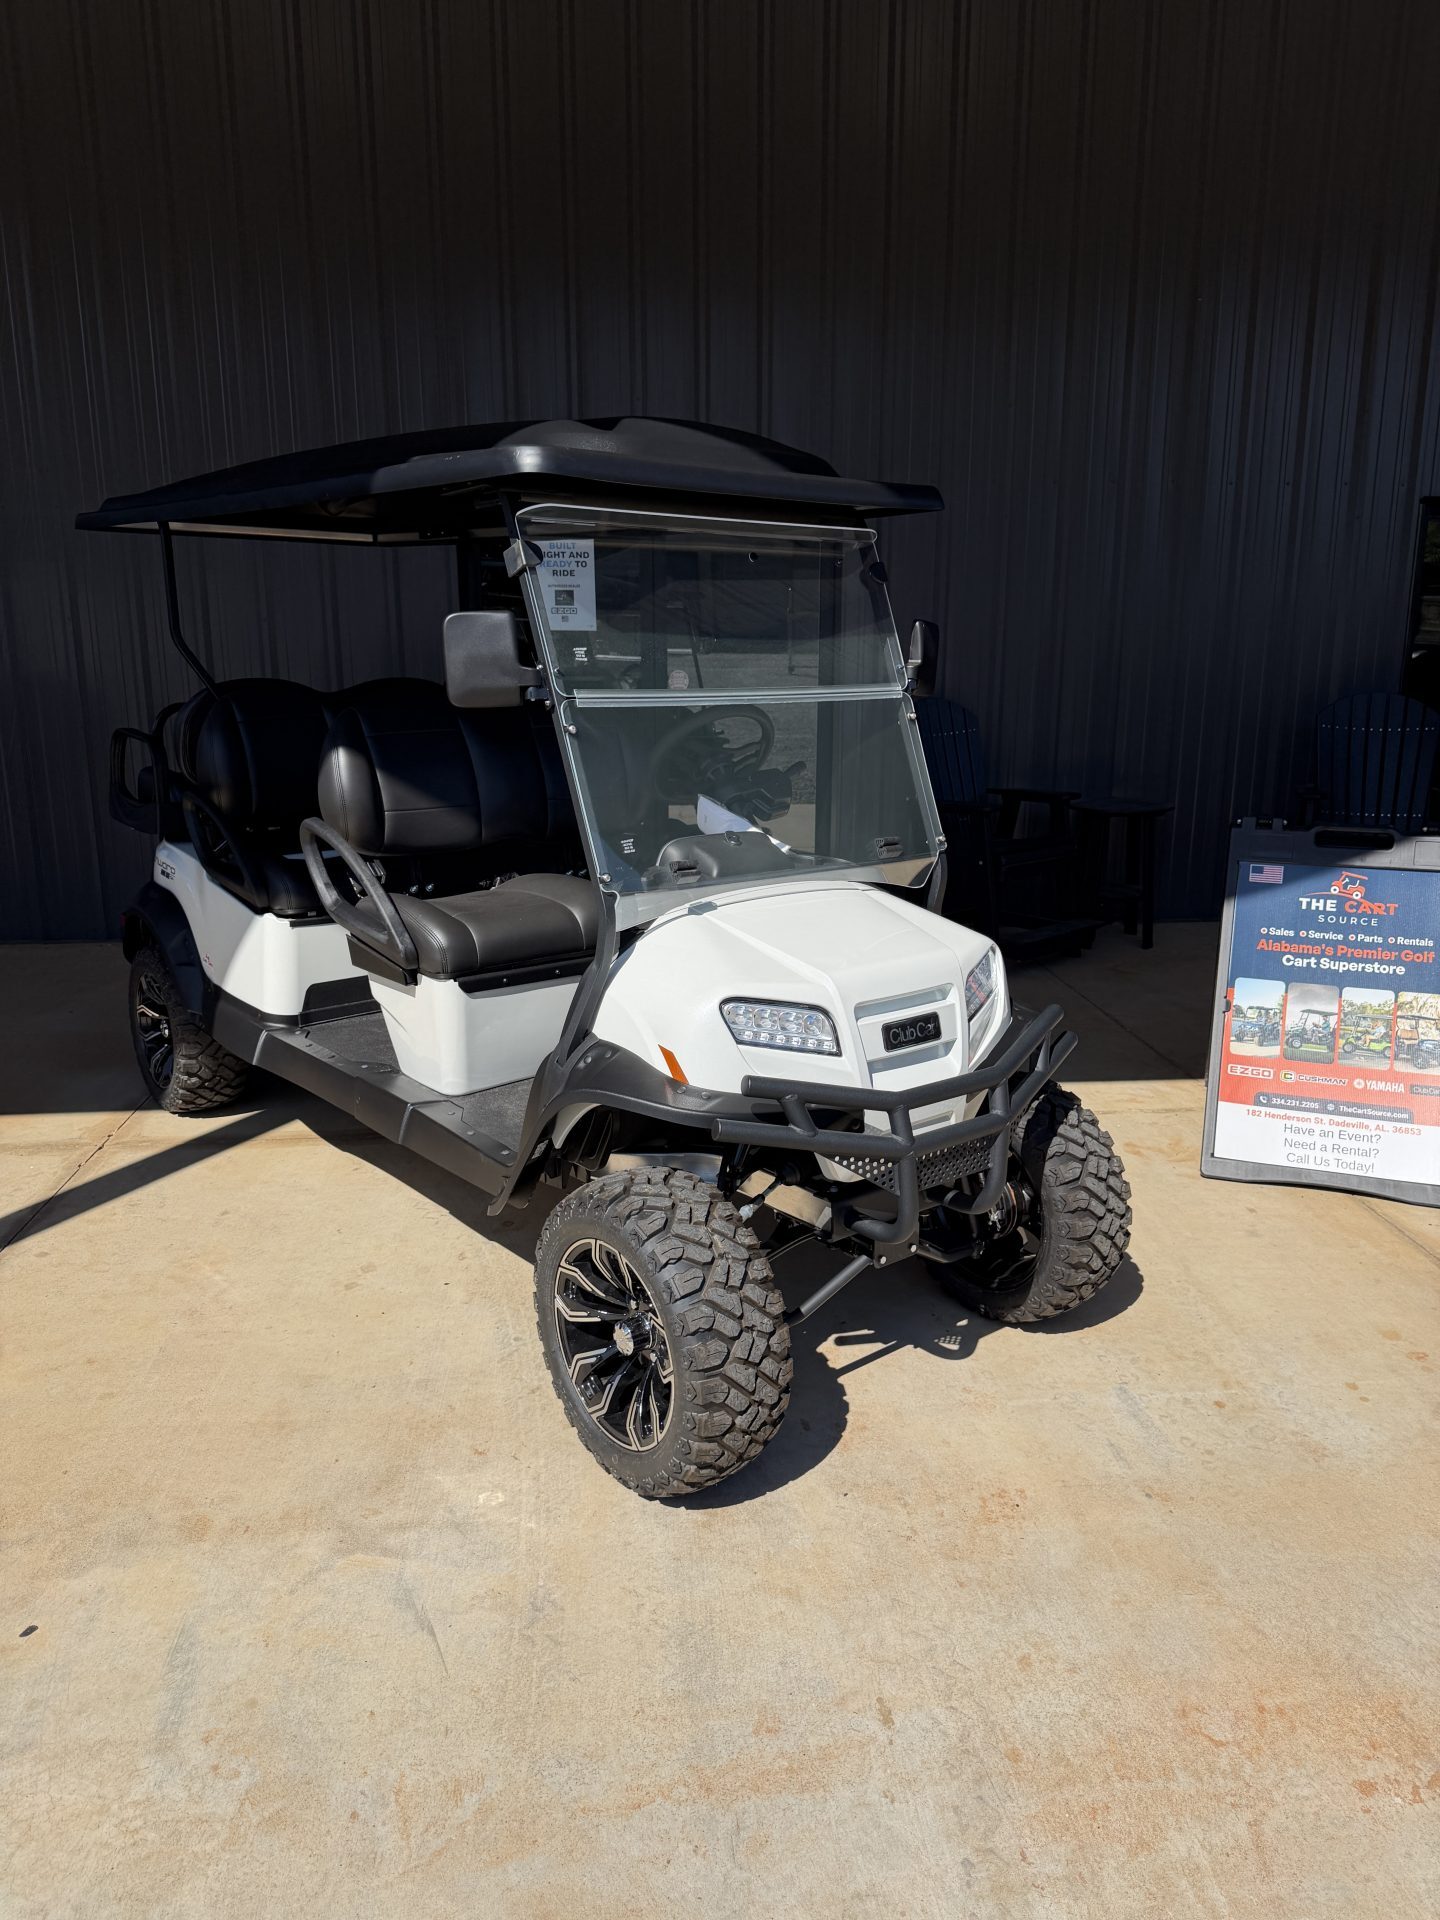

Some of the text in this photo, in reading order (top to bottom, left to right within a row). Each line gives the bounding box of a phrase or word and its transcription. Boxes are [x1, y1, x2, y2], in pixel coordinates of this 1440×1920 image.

[549, 542, 576, 550] BUILT
[543, 551, 590, 559] IGHT AND
[574, 560, 588, 568] TO
[552, 569, 576, 577] RIDE
[1299, 897, 1399, 916] THE CART
[1317, 914, 1379, 927] SOURCE
[1269, 927, 1434, 947] Sales Service Parts Rentals
[1256, 938, 1435, 964] Alabama's Premier Golf
[1282, 954, 1406, 975] Cart Superstore
[1229, 1065, 1273, 1078] EZGO
[1298, 1074, 1347, 1086] CUSHMAN
[1366, 1080, 1405, 1093] YAMAHA
[1271, 1097, 1319, 1109] 334.231.2205
[1339, 1105, 1409, 1119] TheCartSource.com
[1246, 1108, 1422, 1136] 182 Henderson St. Dadeville, AL. 36853
[1283, 1123, 1382, 1144] Have an Event?
[1283, 1138, 1380, 1159] Need a Rental?
[1286, 1152, 1375, 1174] Call Us Today!
